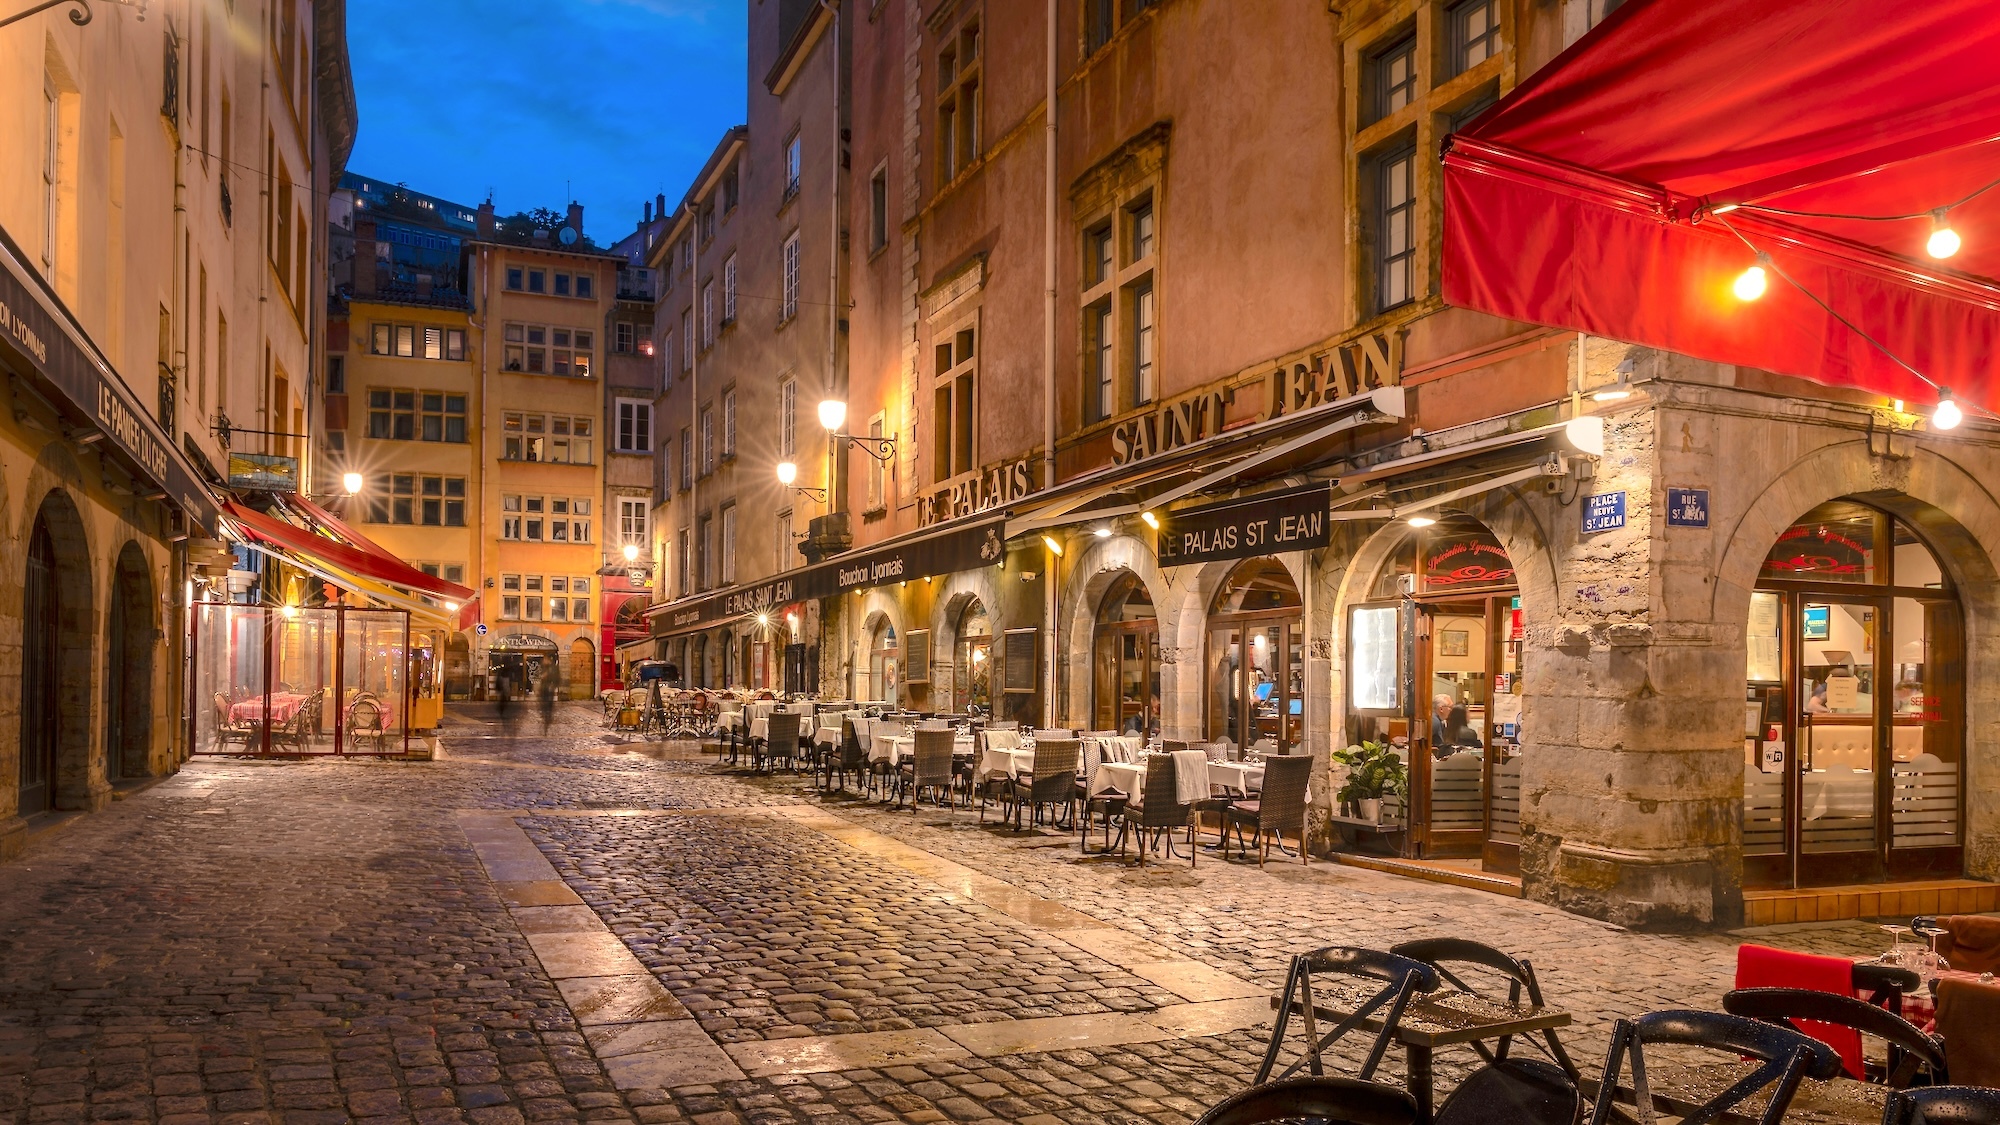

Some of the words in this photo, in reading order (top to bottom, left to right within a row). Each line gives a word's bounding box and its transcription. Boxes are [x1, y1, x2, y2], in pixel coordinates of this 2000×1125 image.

[1110, 385, 1231, 468] SAINT
[1255, 325, 1406, 423] JEAN
[98, 380, 110, 427] LE
[111, 394, 141, 457] PANIER
[141, 428, 152, 468] DU
[151, 441, 168, 482] CHEF
[915, 492, 939, 528] LE
[948, 459, 1028, 520] PALAIS
[1590, 494, 1618, 507] PLACE
[1681, 495, 1697, 505] RUE
[1593, 506, 1615, 516] NEUVE
[1598, 515, 1623, 528] JEAN
[1159, 535, 1177, 558] LE
[1184, 525, 1238, 555] PALAIS
[1245, 520, 1269, 547] ST
[1274, 510, 1322, 543] JEAN
[839, 564, 869, 587] Bouchon
[871, 555, 904, 585] Lyonnais
[725, 597, 734, 615] LE
[733, 590, 754, 613] PALAIS
[755, 584, 773, 608] SAINT
[774, 579, 793, 603] JEAN
[498, 638, 525, 646] ANTIC
[1910, 697, 1942, 707] SERVICE
